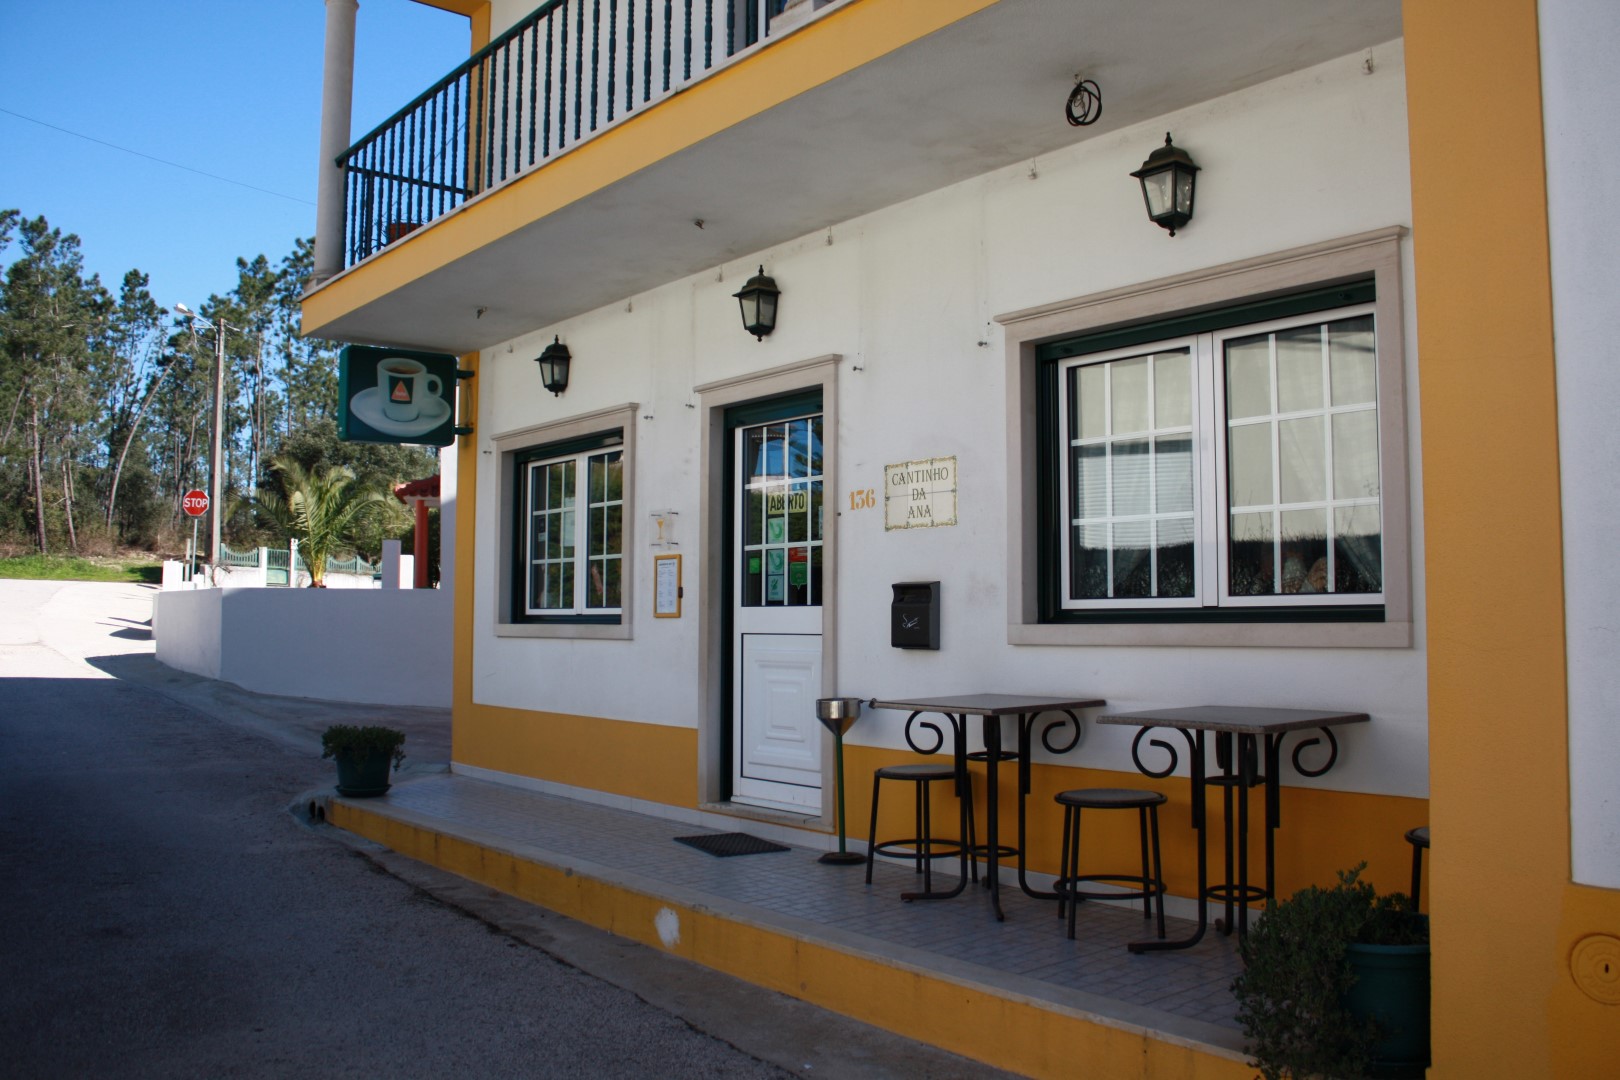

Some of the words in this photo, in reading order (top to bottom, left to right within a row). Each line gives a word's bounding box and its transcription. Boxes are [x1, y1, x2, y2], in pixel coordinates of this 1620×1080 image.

[891, 467, 949, 486] CANTINHO
[911, 488, 927, 501] DA
[184, 497, 208, 508] STOP
[907, 505, 932, 519] ANA
